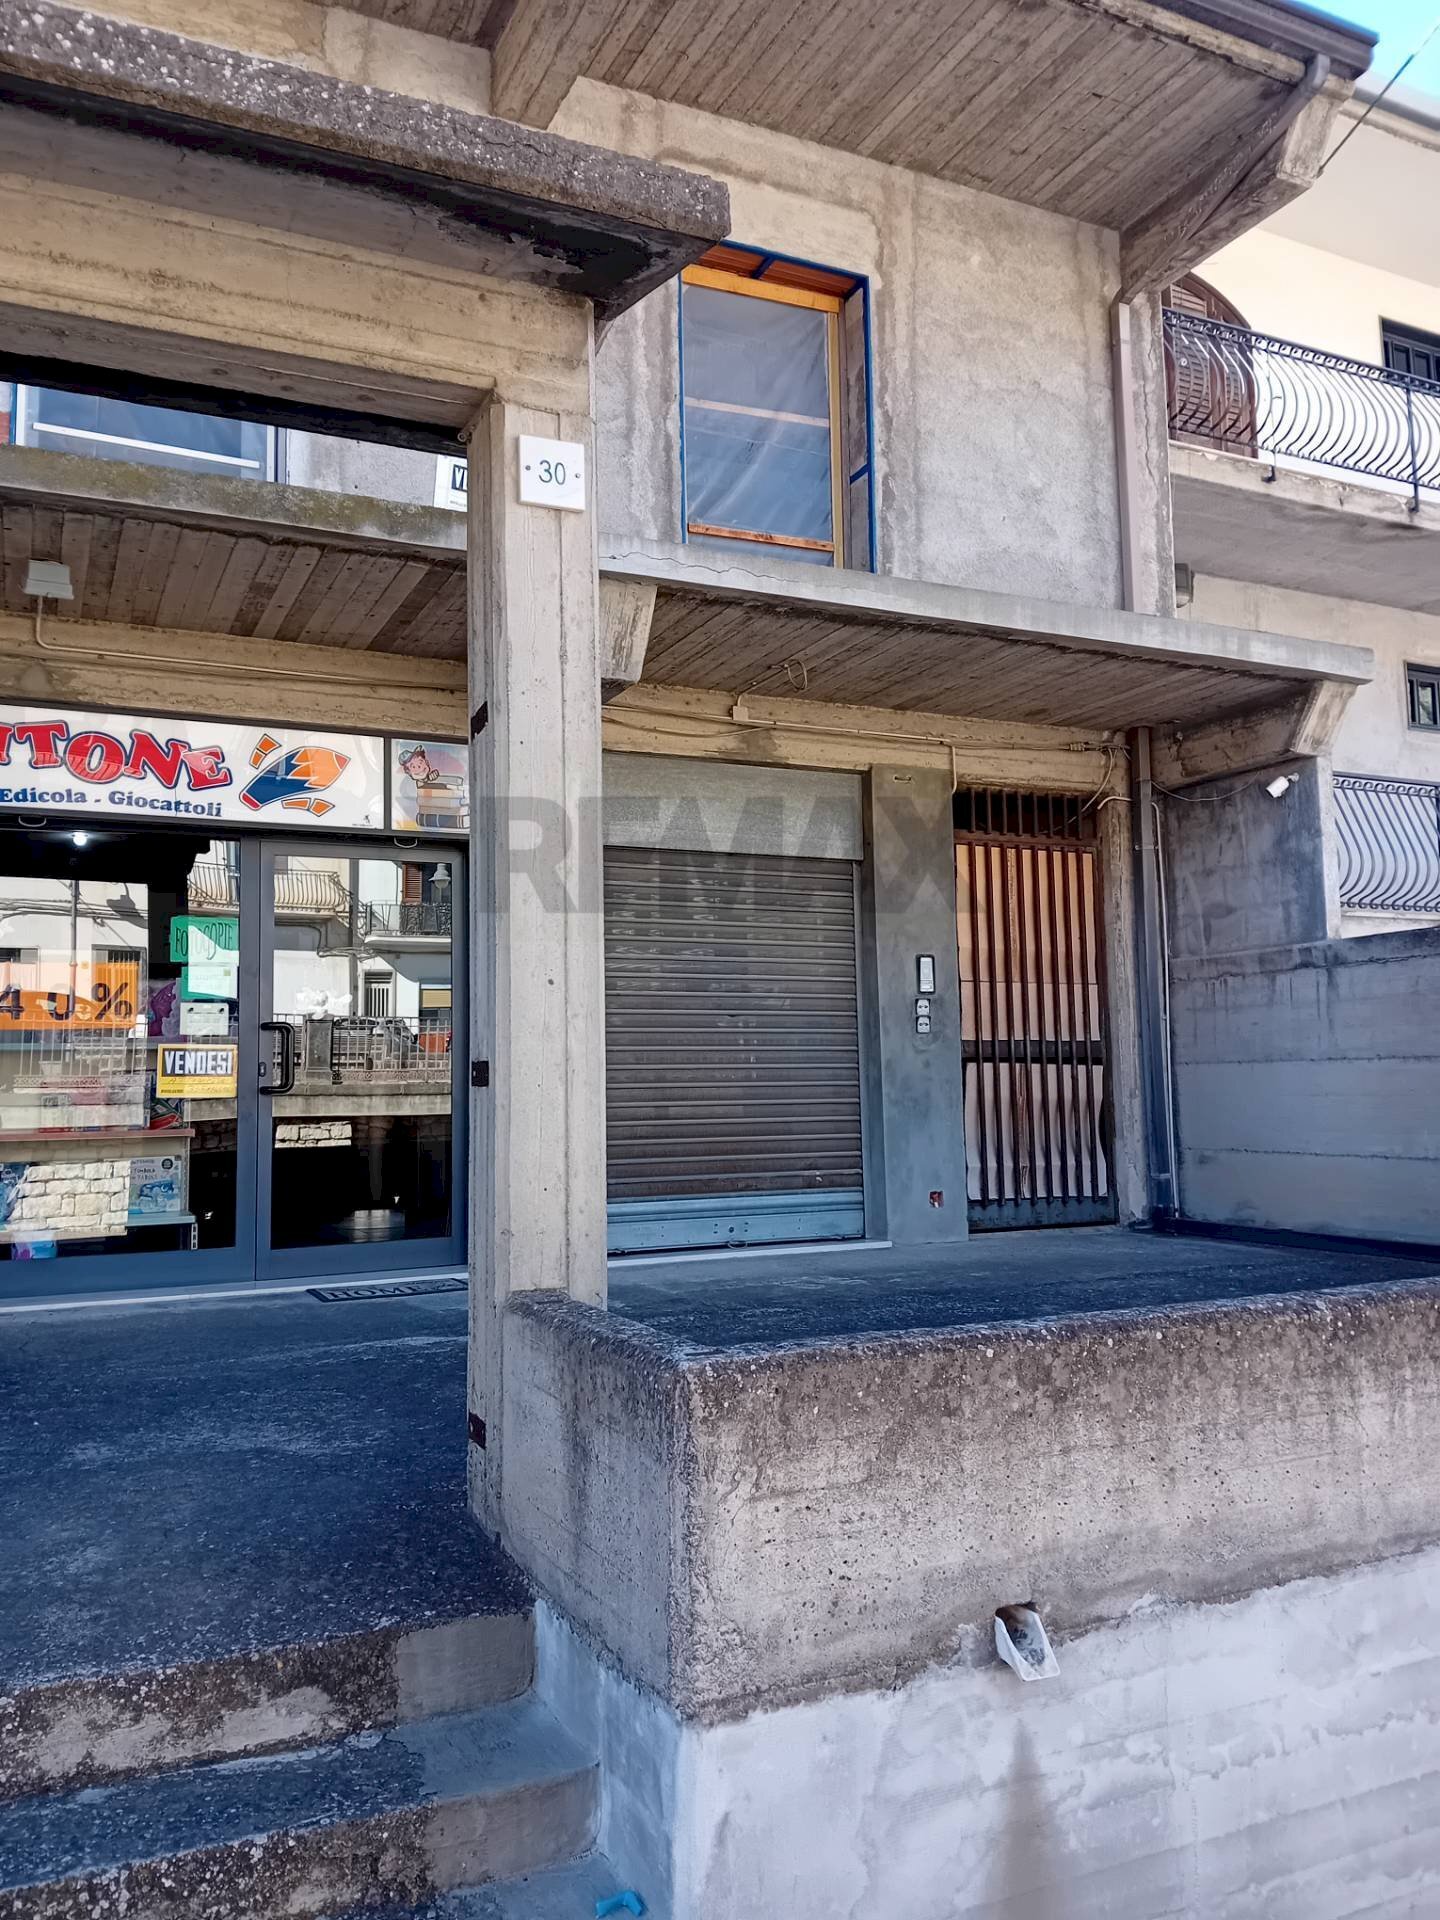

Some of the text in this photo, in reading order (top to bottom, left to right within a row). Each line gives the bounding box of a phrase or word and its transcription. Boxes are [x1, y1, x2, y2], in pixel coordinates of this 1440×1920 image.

[538, 459, 567, 485] 30
[0, 788, 88, 804] Edicola
[108, 790, 223, 818] Giocattoli
[164, 1050, 233, 1075] VENDESI
